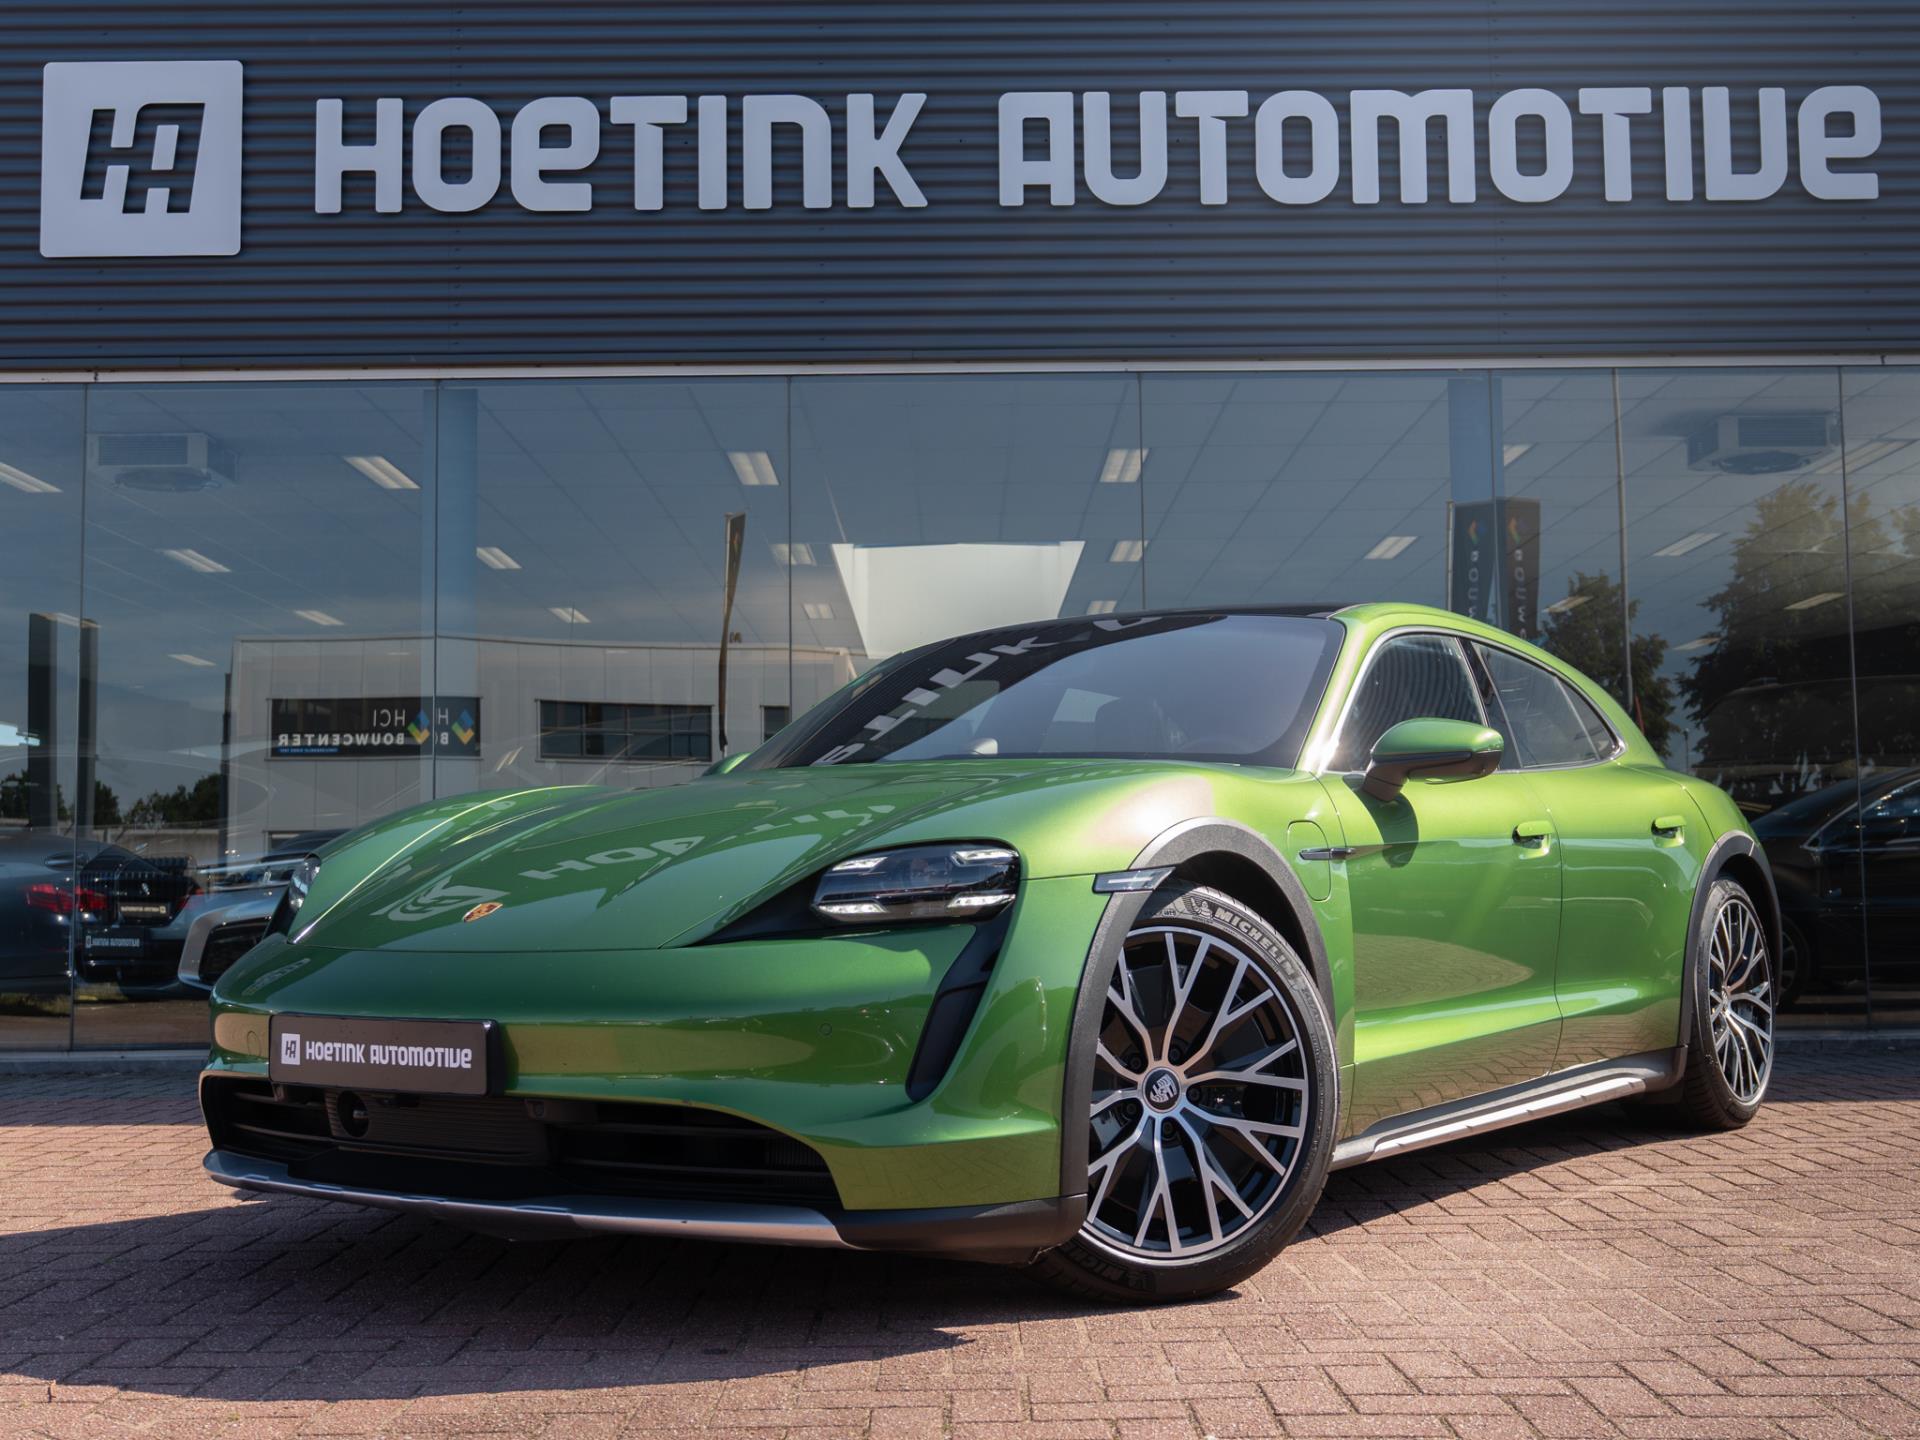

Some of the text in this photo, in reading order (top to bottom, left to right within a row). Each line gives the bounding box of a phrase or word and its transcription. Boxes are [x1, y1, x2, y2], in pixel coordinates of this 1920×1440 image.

[315, 93, 928, 214] HOETINK
[998, 85, 1882, 206] AUTOMOTIVE
[1214, 906, 1296, 978] MICHELIN
[305, 1041, 366, 1063] HOETINK
[370, 1045, 472, 1069] AUTOMOTIVE
